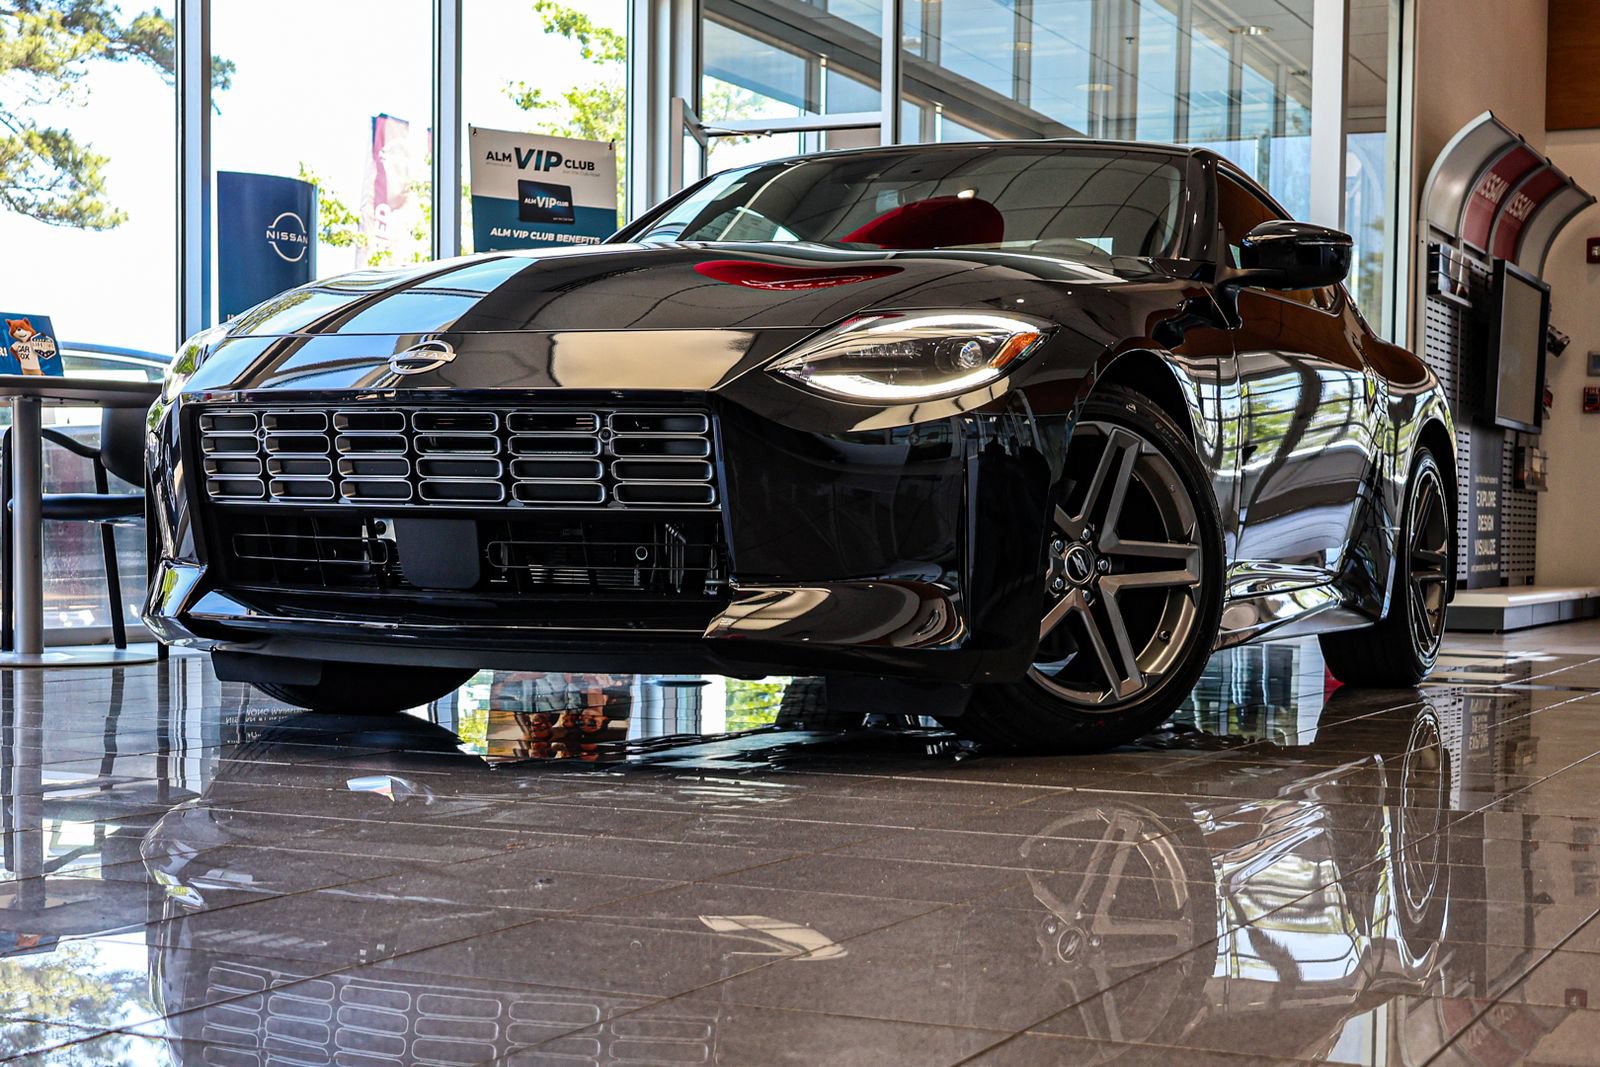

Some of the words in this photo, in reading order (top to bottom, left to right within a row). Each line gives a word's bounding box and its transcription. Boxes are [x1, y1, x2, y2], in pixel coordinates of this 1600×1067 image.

[486, 150, 512, 163] ALM
[514, 147, 563, 172] VIP
[564, 159, 596, 171] CLUB
[524, 197, 537, 205] ALM
[536, 196, 558, 209] VIP
[266, 230, 309, 245] NISSAN
[490, 228, 511, 237] ALM
[513, 229, 529, 239] VIP
[530, 231, 555, 241] CLUB
[556, 233, 601, 245] BENEFITS
[390, 350, 456, 361] SSAN
